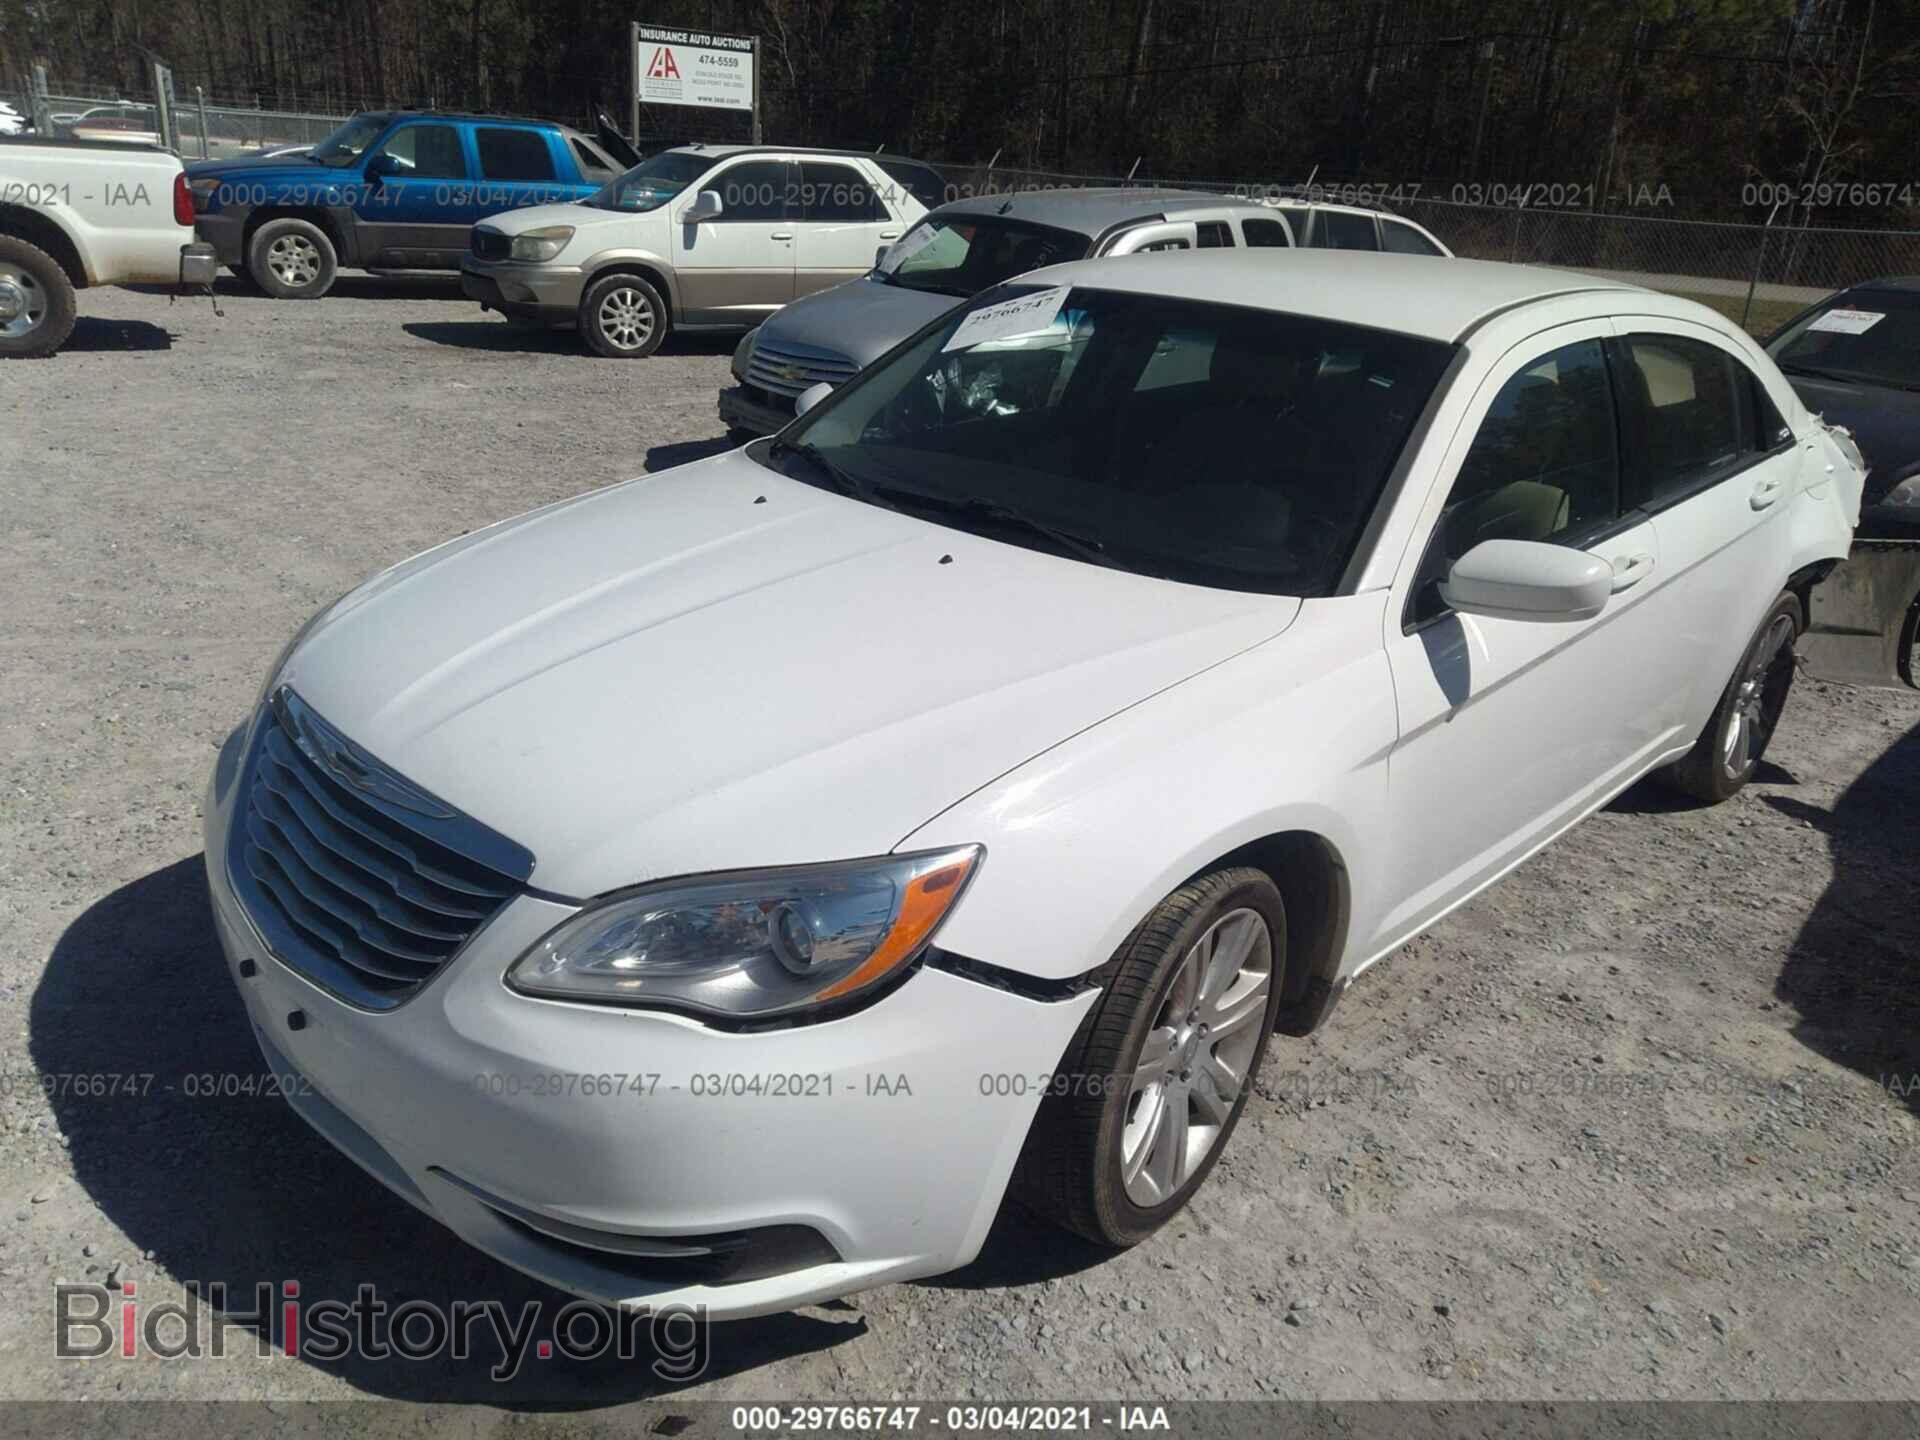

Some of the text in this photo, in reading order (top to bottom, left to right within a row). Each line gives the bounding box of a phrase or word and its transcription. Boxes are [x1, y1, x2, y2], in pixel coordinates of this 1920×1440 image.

[640, 28, 752, 50] INSURANCE AUTO AUCTIONS
[698, 55, 739, 68] 474-5559
